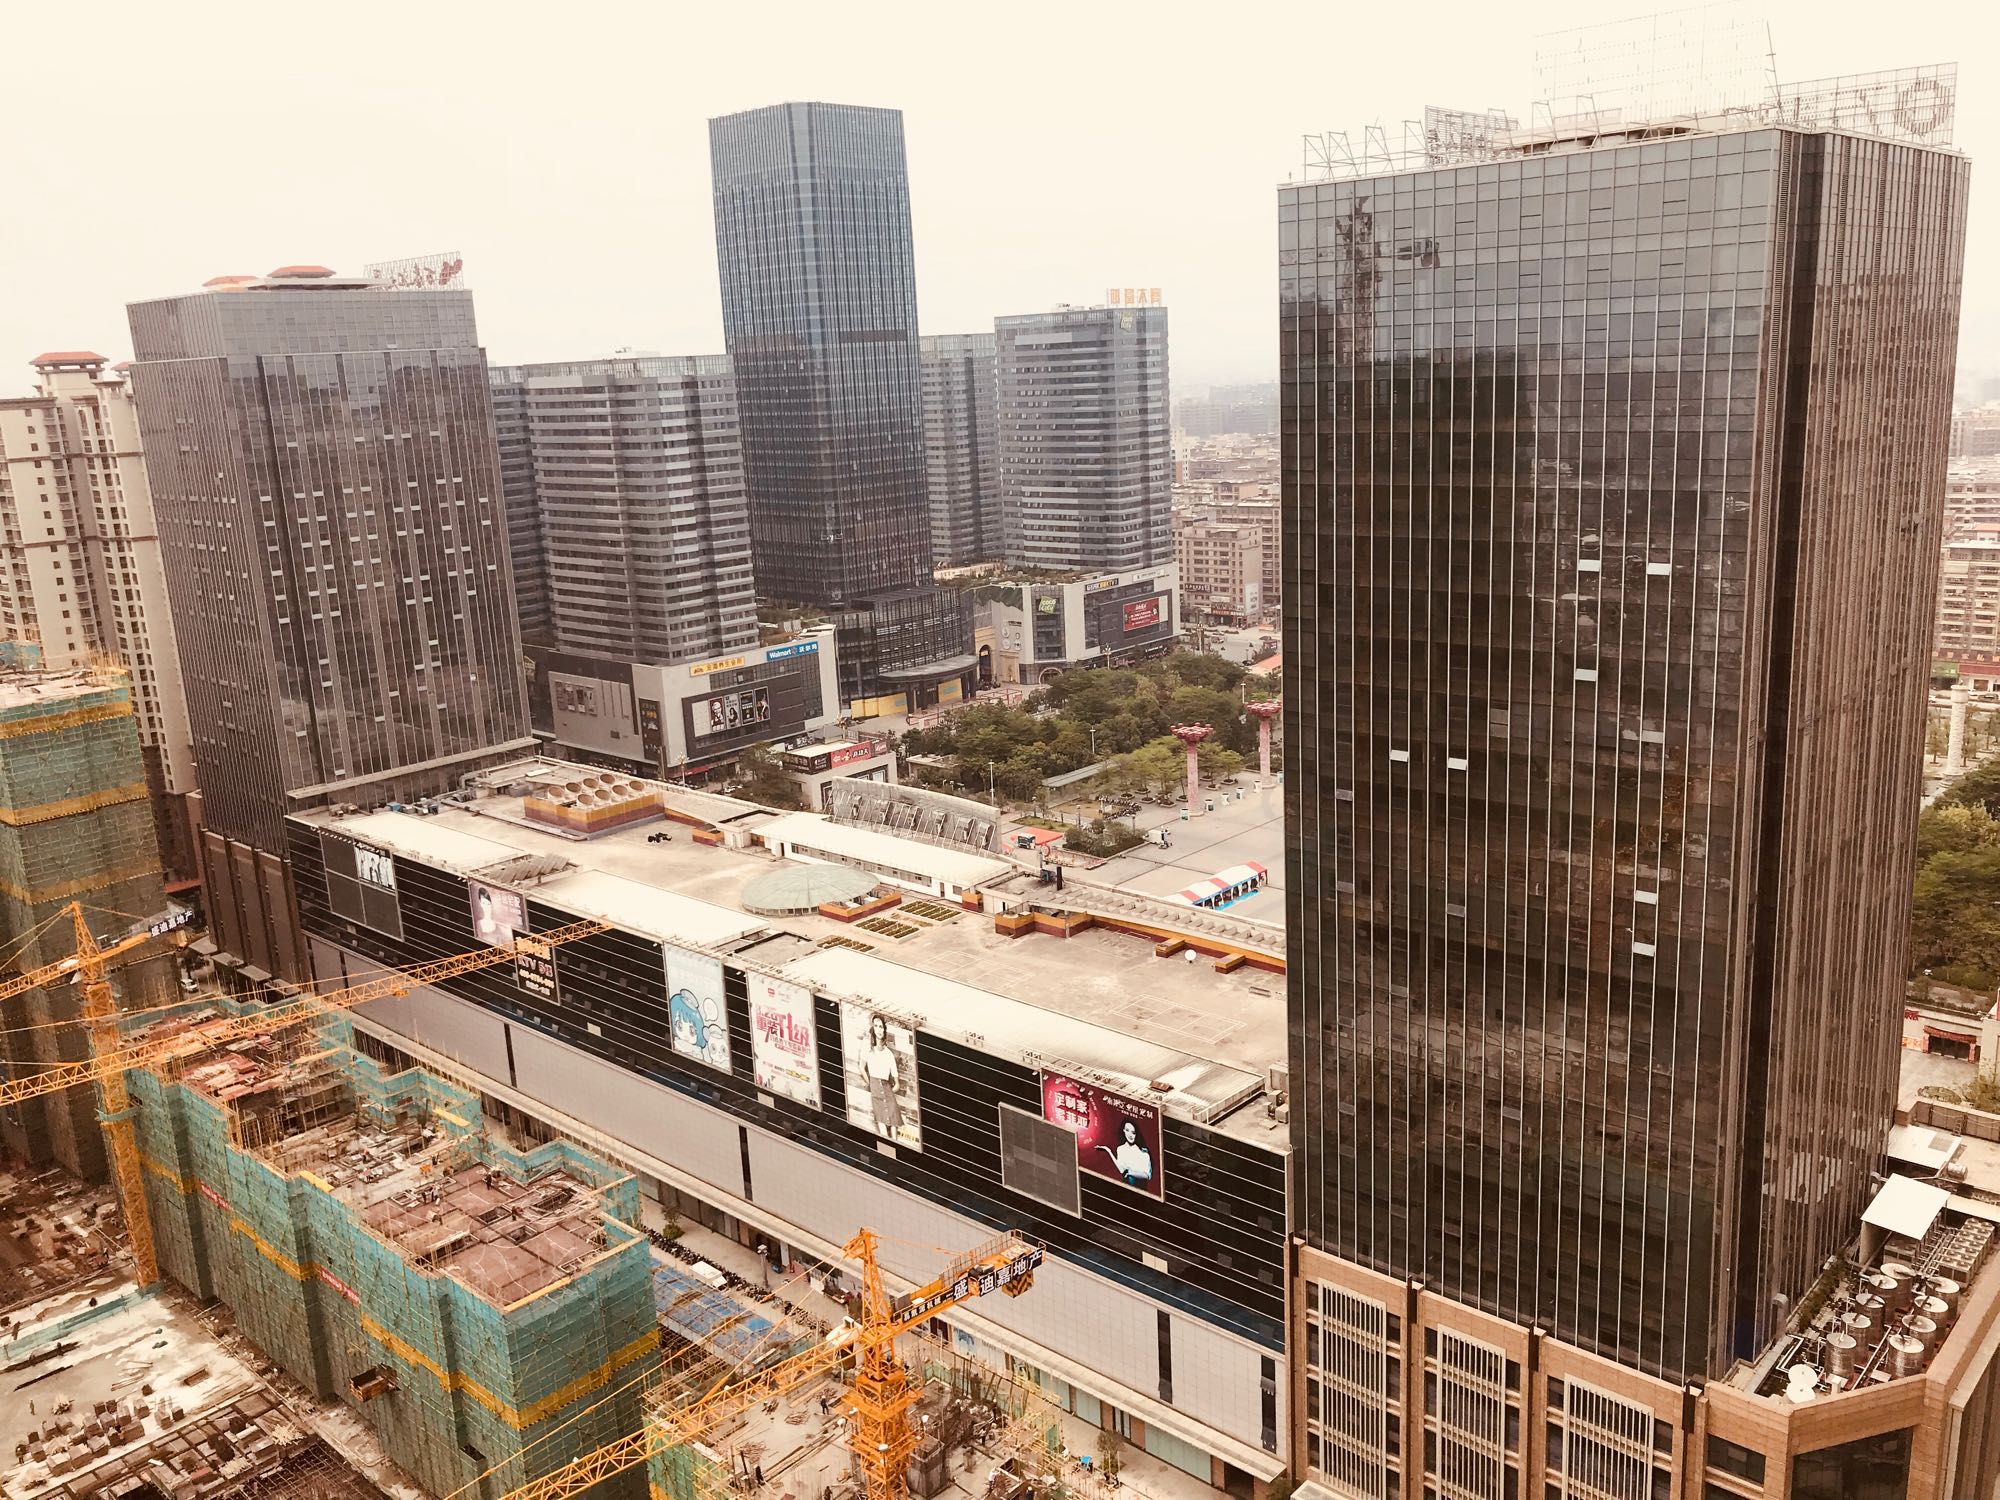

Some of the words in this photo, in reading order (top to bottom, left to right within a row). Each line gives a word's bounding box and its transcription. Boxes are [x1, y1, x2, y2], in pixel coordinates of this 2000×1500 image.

[769, 648, 792, 659] Walmart
[1054, 1091, 1089, 1114] 定制家
[954, 1249, 1043, 1301] 盛迪嘉地产
